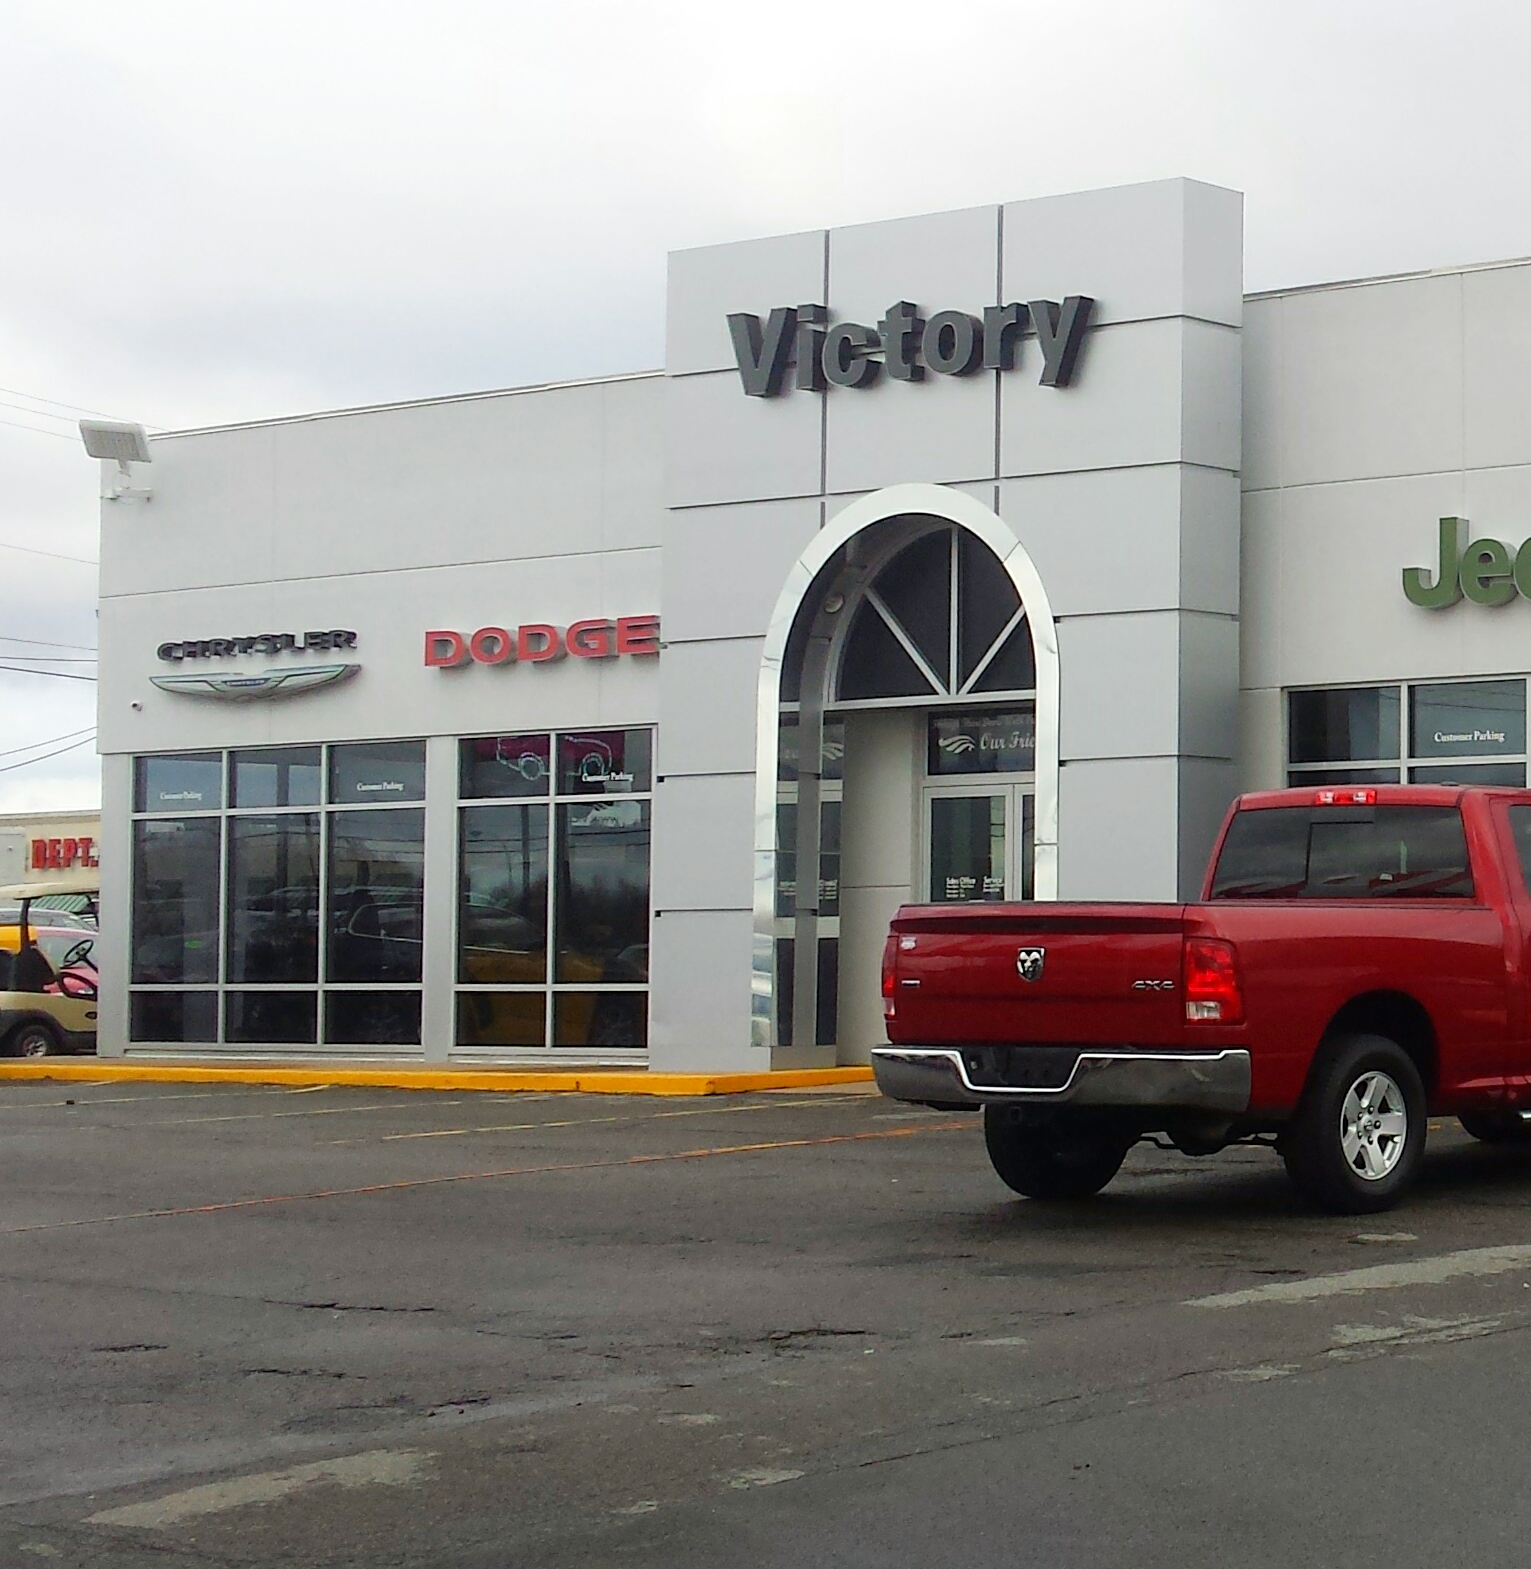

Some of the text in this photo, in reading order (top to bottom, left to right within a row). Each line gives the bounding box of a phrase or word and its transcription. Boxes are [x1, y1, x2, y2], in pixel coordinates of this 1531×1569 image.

[727, 296, 1096, 398] Victory
[157, 629, 358, 660] CHRYSLER
[425, 614, 660, 668] DODGE
[980, 732, 1006, 750] Our
[1434, 730, 1505, 743] Customer Parking
